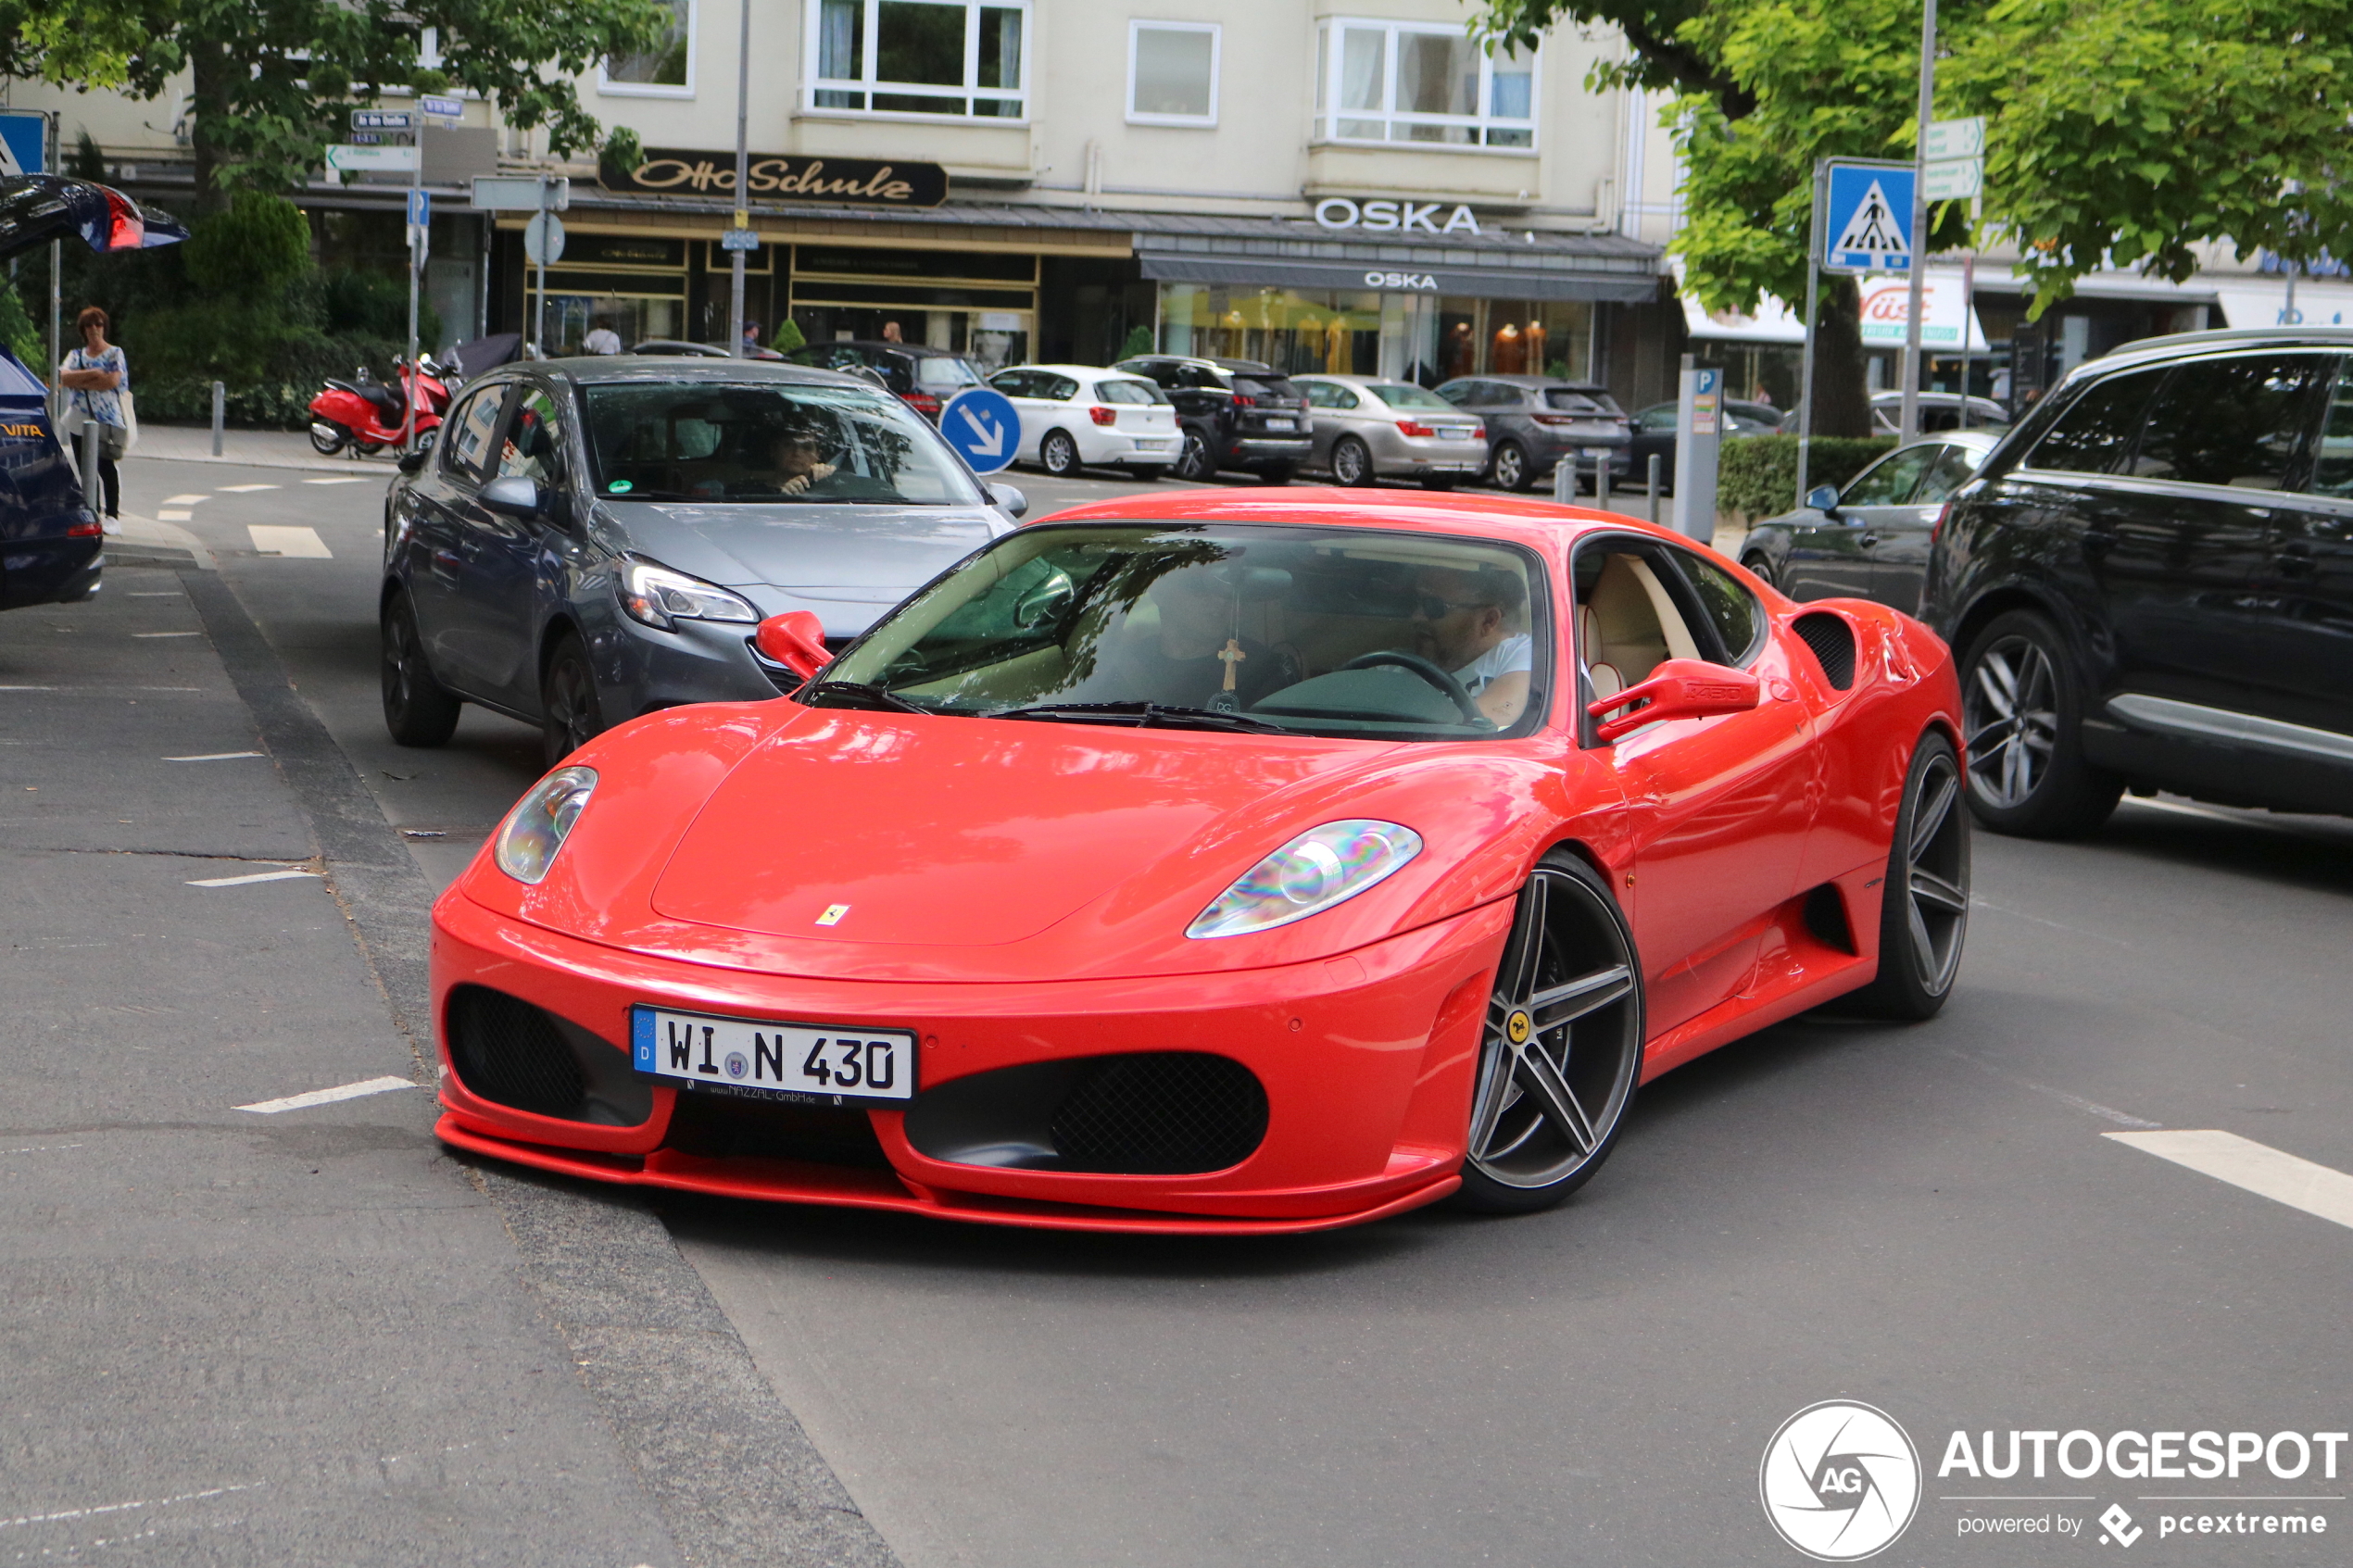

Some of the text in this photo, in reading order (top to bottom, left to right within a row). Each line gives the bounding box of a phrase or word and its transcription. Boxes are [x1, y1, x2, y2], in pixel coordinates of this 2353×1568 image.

[632, 158, 914, 200] Otto Schulz
[1315, 197, 1482, 235] OSKA
[1365, 270, 1438, 290] OSKA
[1700, 371, 1712, 391] P
[640, 1021, 894, 1089] D WI N 430
